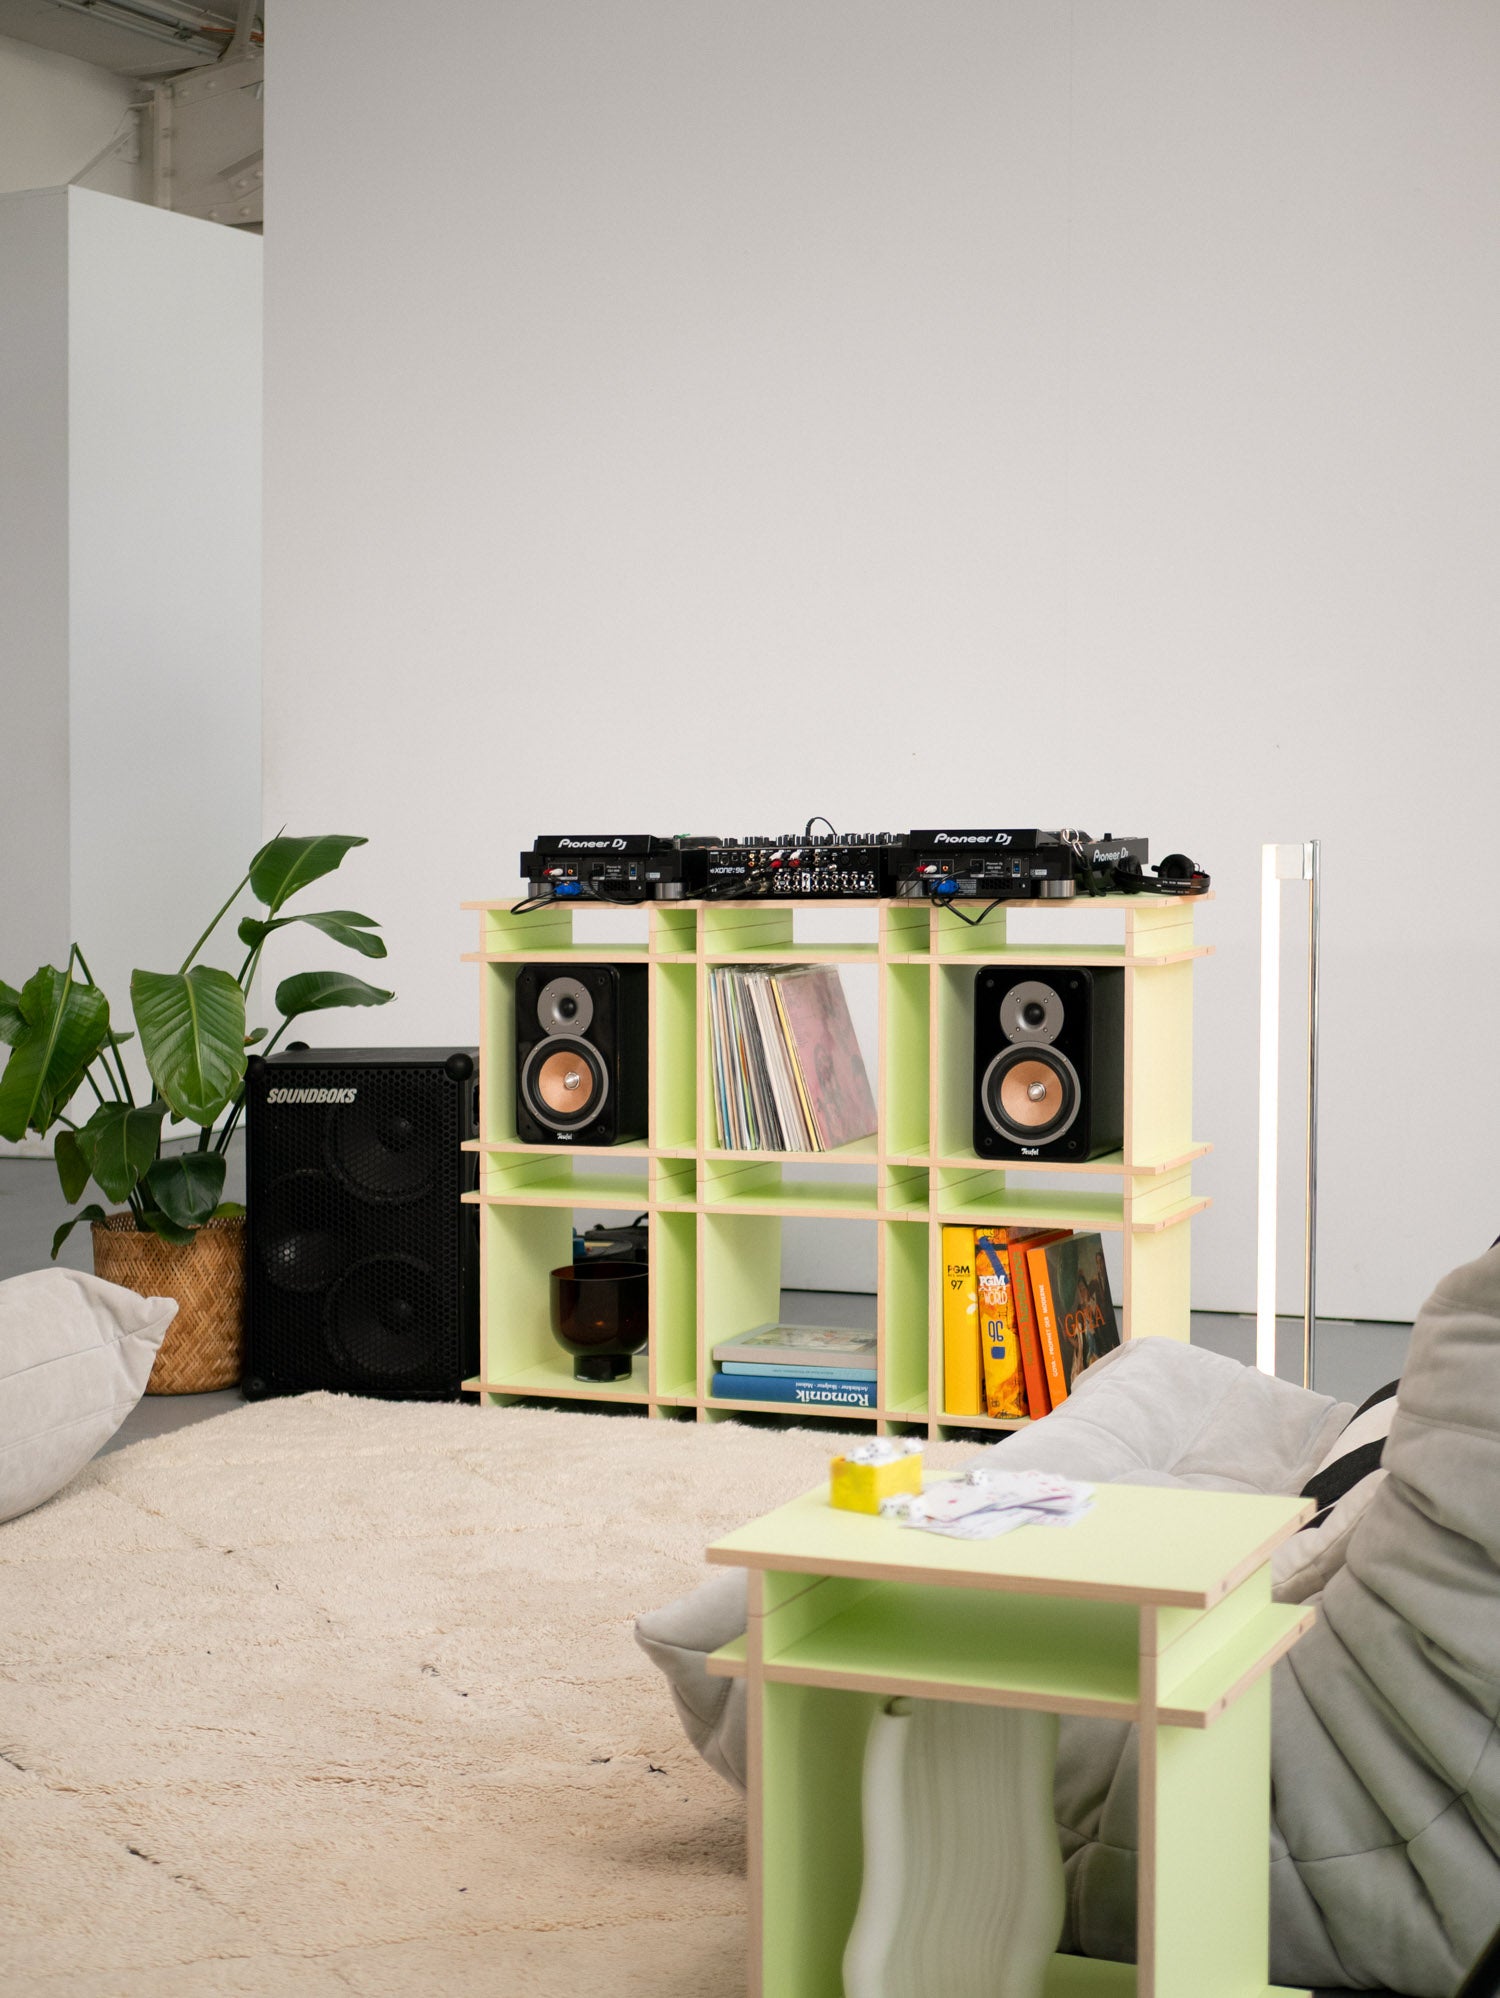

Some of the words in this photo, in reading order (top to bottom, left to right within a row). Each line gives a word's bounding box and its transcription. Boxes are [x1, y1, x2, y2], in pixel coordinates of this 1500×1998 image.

[558, 838, 610, 848] Pioneer
[934, 833, 993, 843] Pioneer
[1093, 849, 1120, 863] Pioneer
[267, 1088, 358, 1104] SOUNDBOKS
[951, 1280, 963, 1290] 97
[979, 1275, 1006, 1286] PGM
[1064, 1303, 1105, 1337] GOYA
[795, 1389, 869, 1407] Romanik
